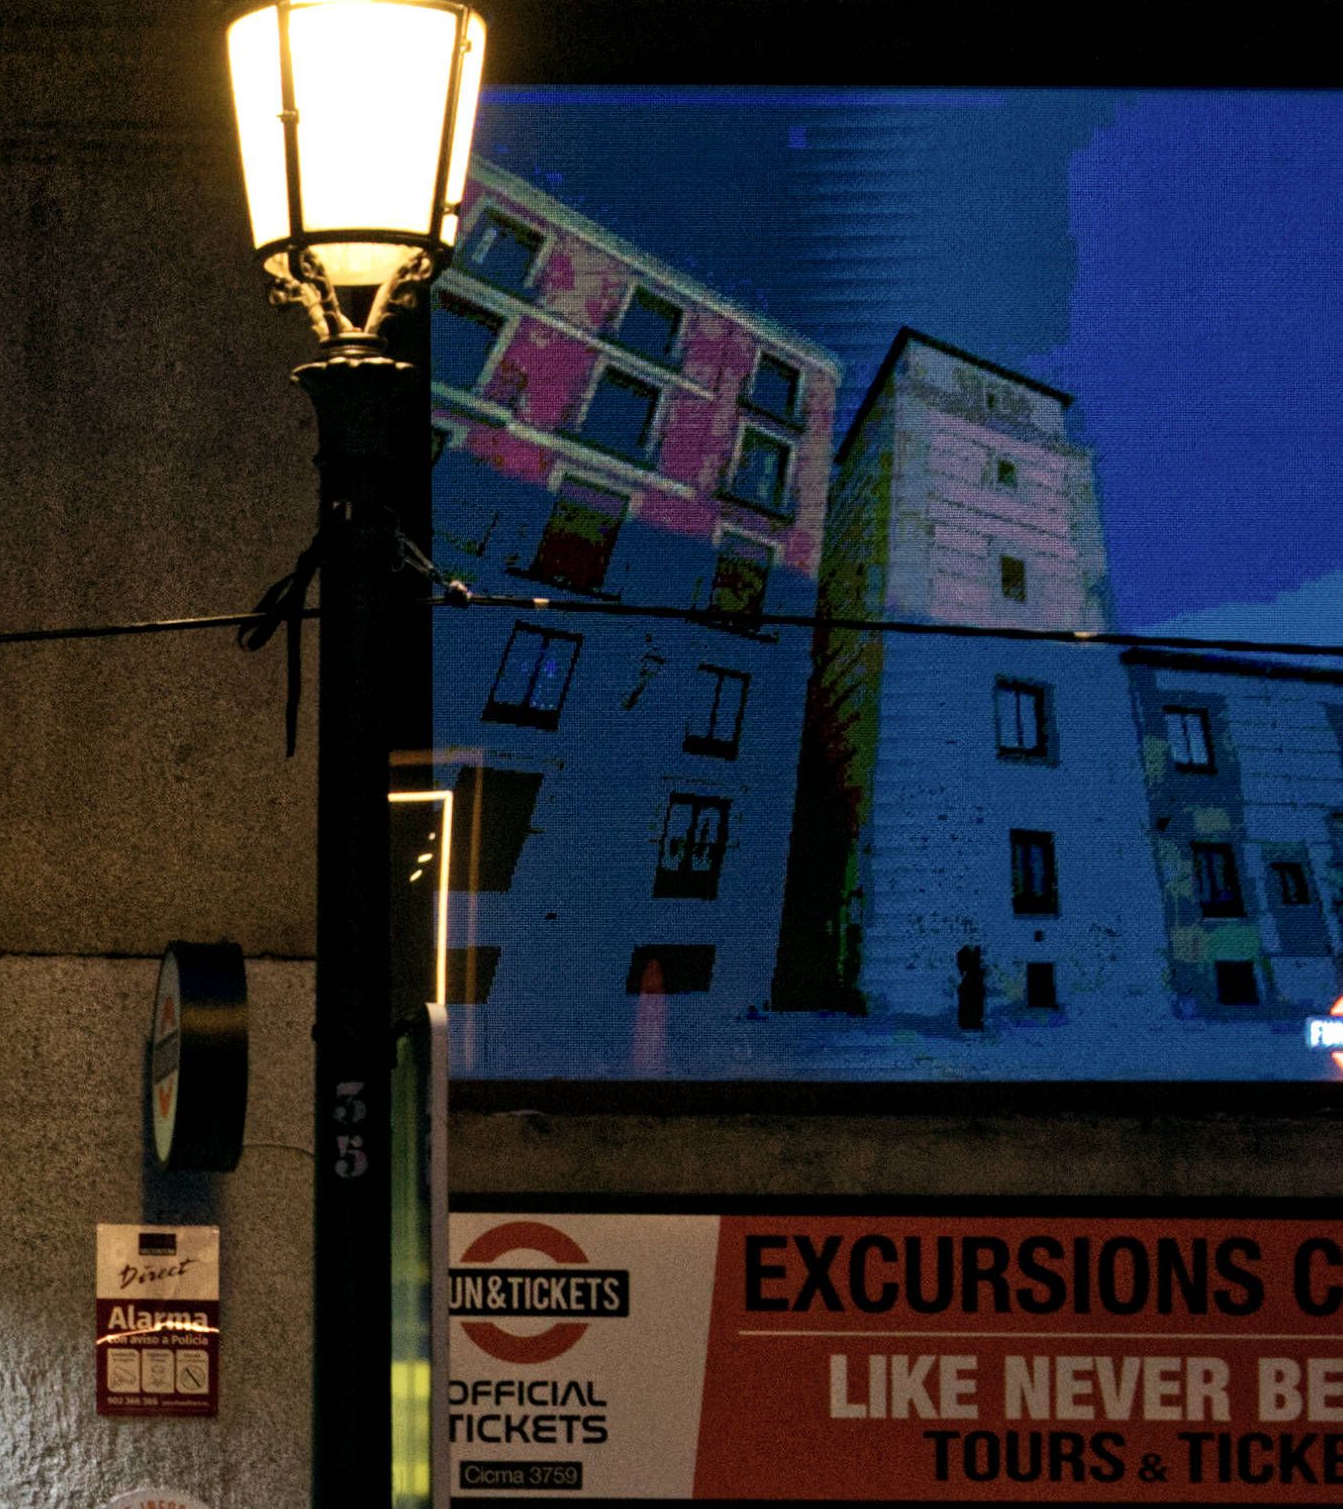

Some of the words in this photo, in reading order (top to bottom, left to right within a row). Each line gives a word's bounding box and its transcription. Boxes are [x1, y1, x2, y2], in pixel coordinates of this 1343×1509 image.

[118, 1258, 198, 1289] Direct
[745, 1235, 1264, 1316] EXCURSIONS
[108, 1306, 208, 1330] Alarma
[449, 1380, 607, 1407] OFFICIAL
[829, 1354, 979, 1419] LIKE
[1004, 1356, 1230, 1421] NEVER
[1258, 1357, 1343, 1422] BE
[449, 1414, 608, 1443] TICKETS
[923, 1430, 1125, 1482] TOURS
[1138, 1453, 1167, 1482] &
[465, 1465, 524, 1483] Cicma
[530, 1465, 578, 1484] 3759
